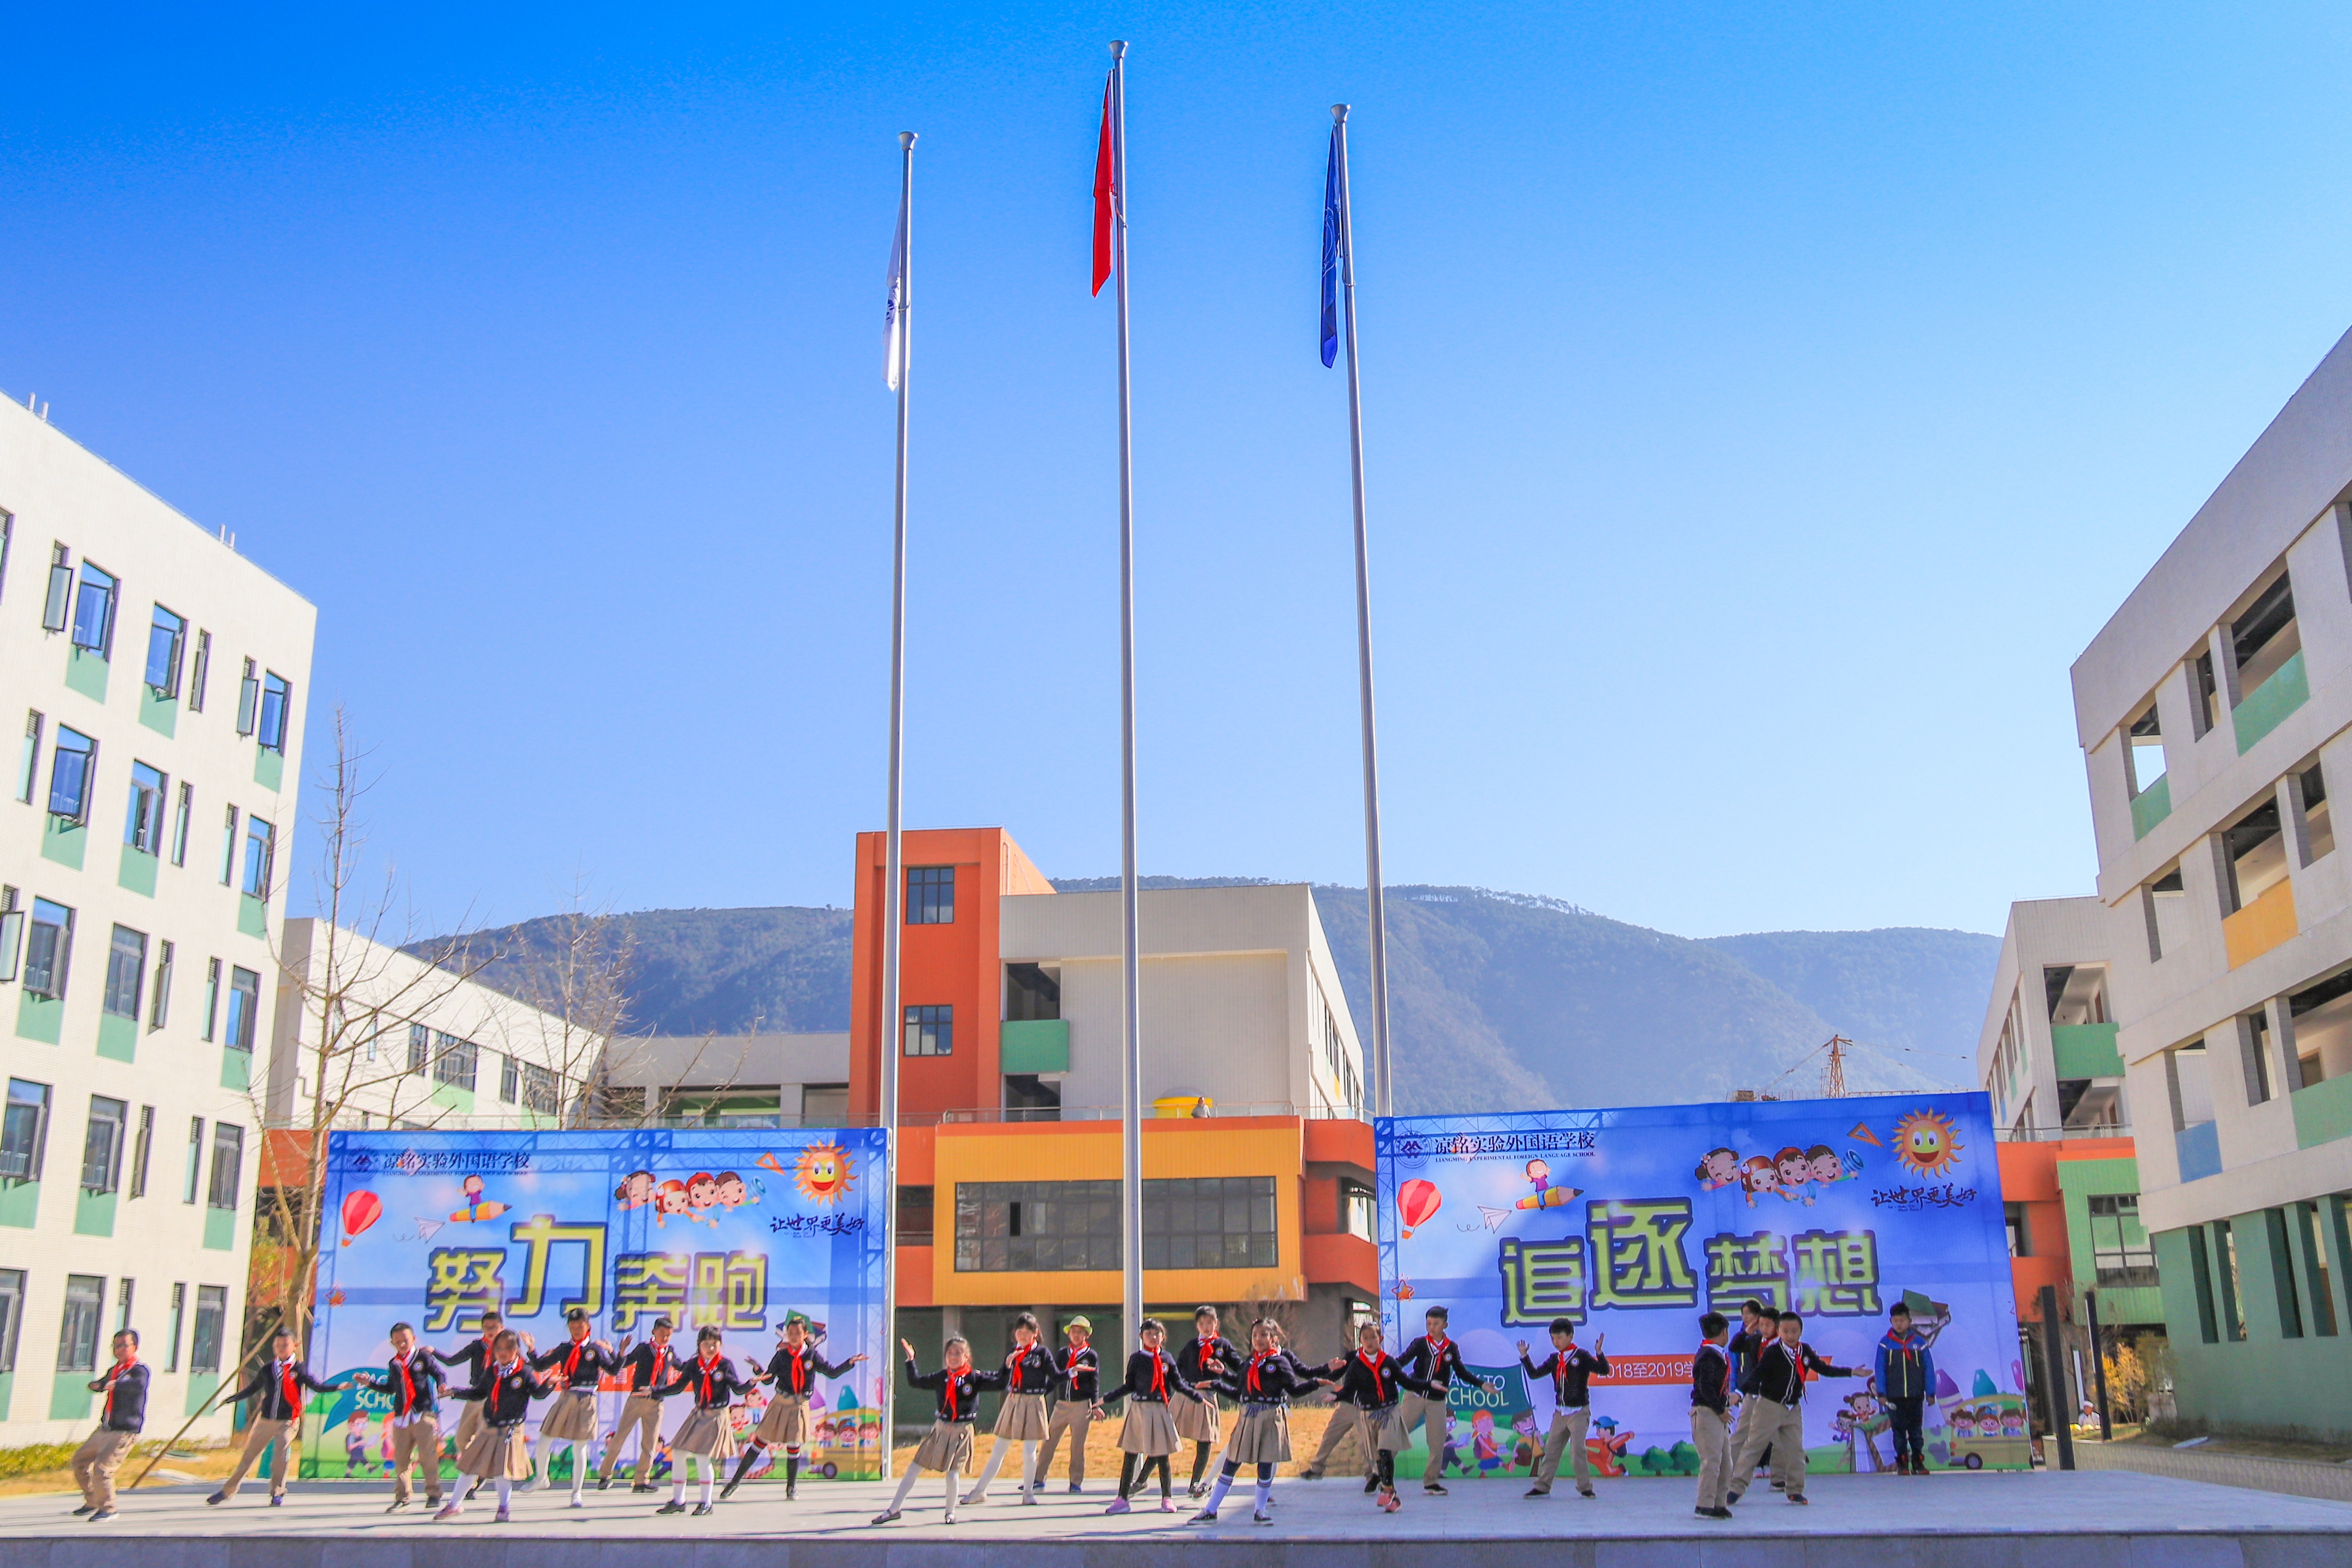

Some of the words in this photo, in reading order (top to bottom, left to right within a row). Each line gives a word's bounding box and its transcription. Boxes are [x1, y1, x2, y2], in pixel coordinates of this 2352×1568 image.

[1435, 1132, 1595, 1154] 凉铭实验外国语学校
[383, 1152, 531, 1169] 凉铭实验外国语学校
[1871, 1182, 1977, 1210] 让世界更美好
[770, 1211, 865, 1237] 让世界更美好
[425, 1215, 768, 1333] 努力奔跑
[1500, 1197, 1883, 1328] 追逐梦想
[1445, 1387, 1509, 1408] CHOOL
